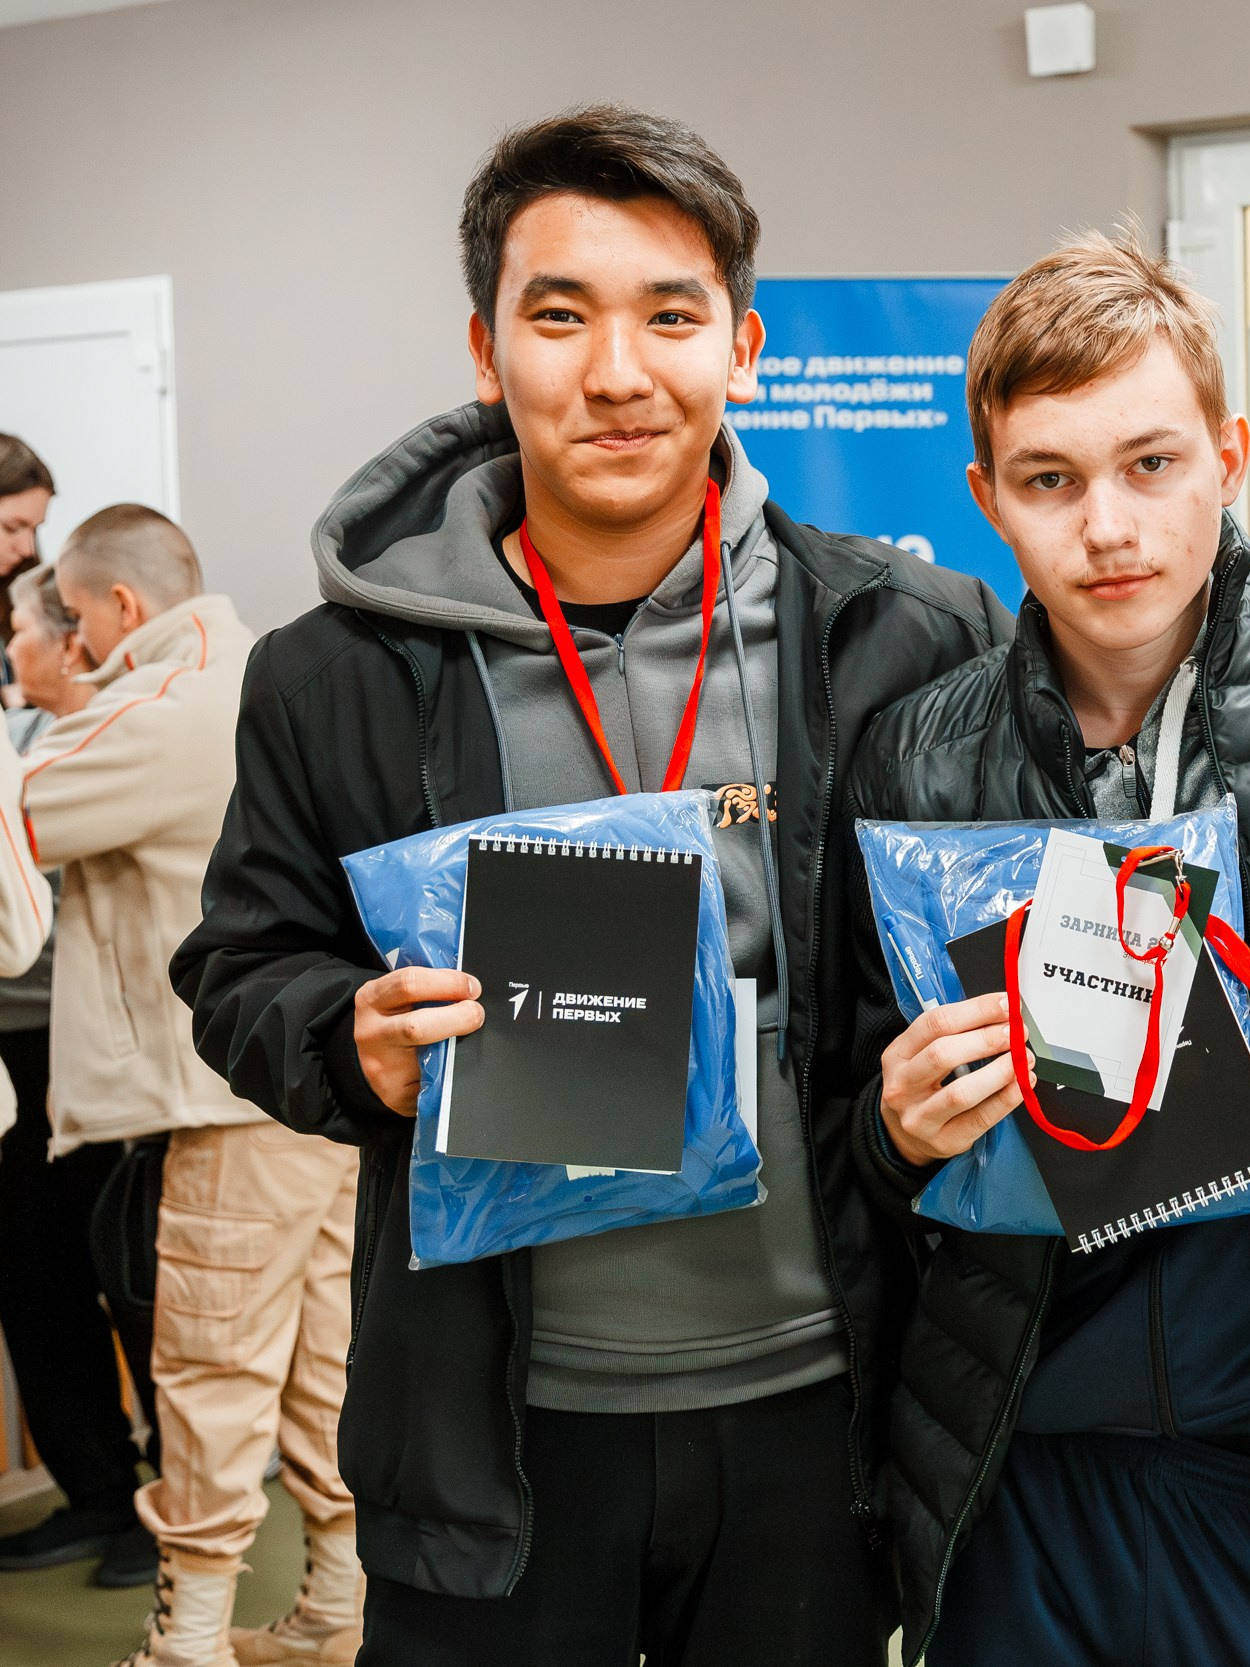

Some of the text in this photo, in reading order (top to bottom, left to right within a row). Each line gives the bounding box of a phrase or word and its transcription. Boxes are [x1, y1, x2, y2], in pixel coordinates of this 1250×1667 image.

[804, 354, 965, 379] движение
[769, 377, 934, 405] молодёжи
[904, 945, 924, 980] Первые
[508, 981, 530, 990] Первые
[552, 992, 647, 1009] ДВИЖЕНИЕ
[552, 1007, 622, 1023] ПЕРВЫХ
